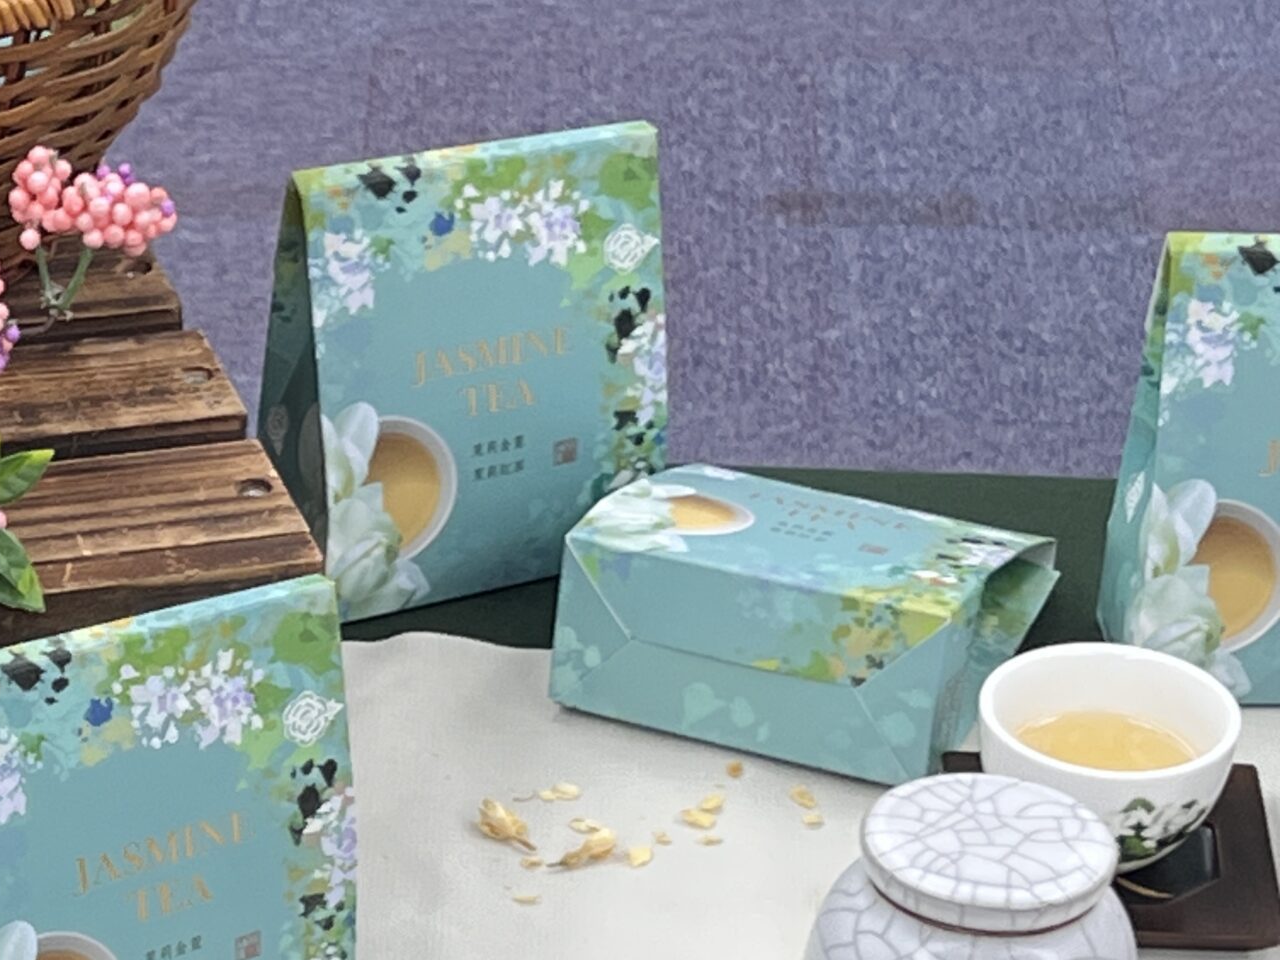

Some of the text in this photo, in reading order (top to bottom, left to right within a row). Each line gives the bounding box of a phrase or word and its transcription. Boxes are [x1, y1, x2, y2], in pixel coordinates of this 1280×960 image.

[411, 325, 573, 388] JASMINE
[458, 377, 535, 417] TEA
[73, 811, 257, 897] JASMINE
[123, 873, 214, 923] TEA
